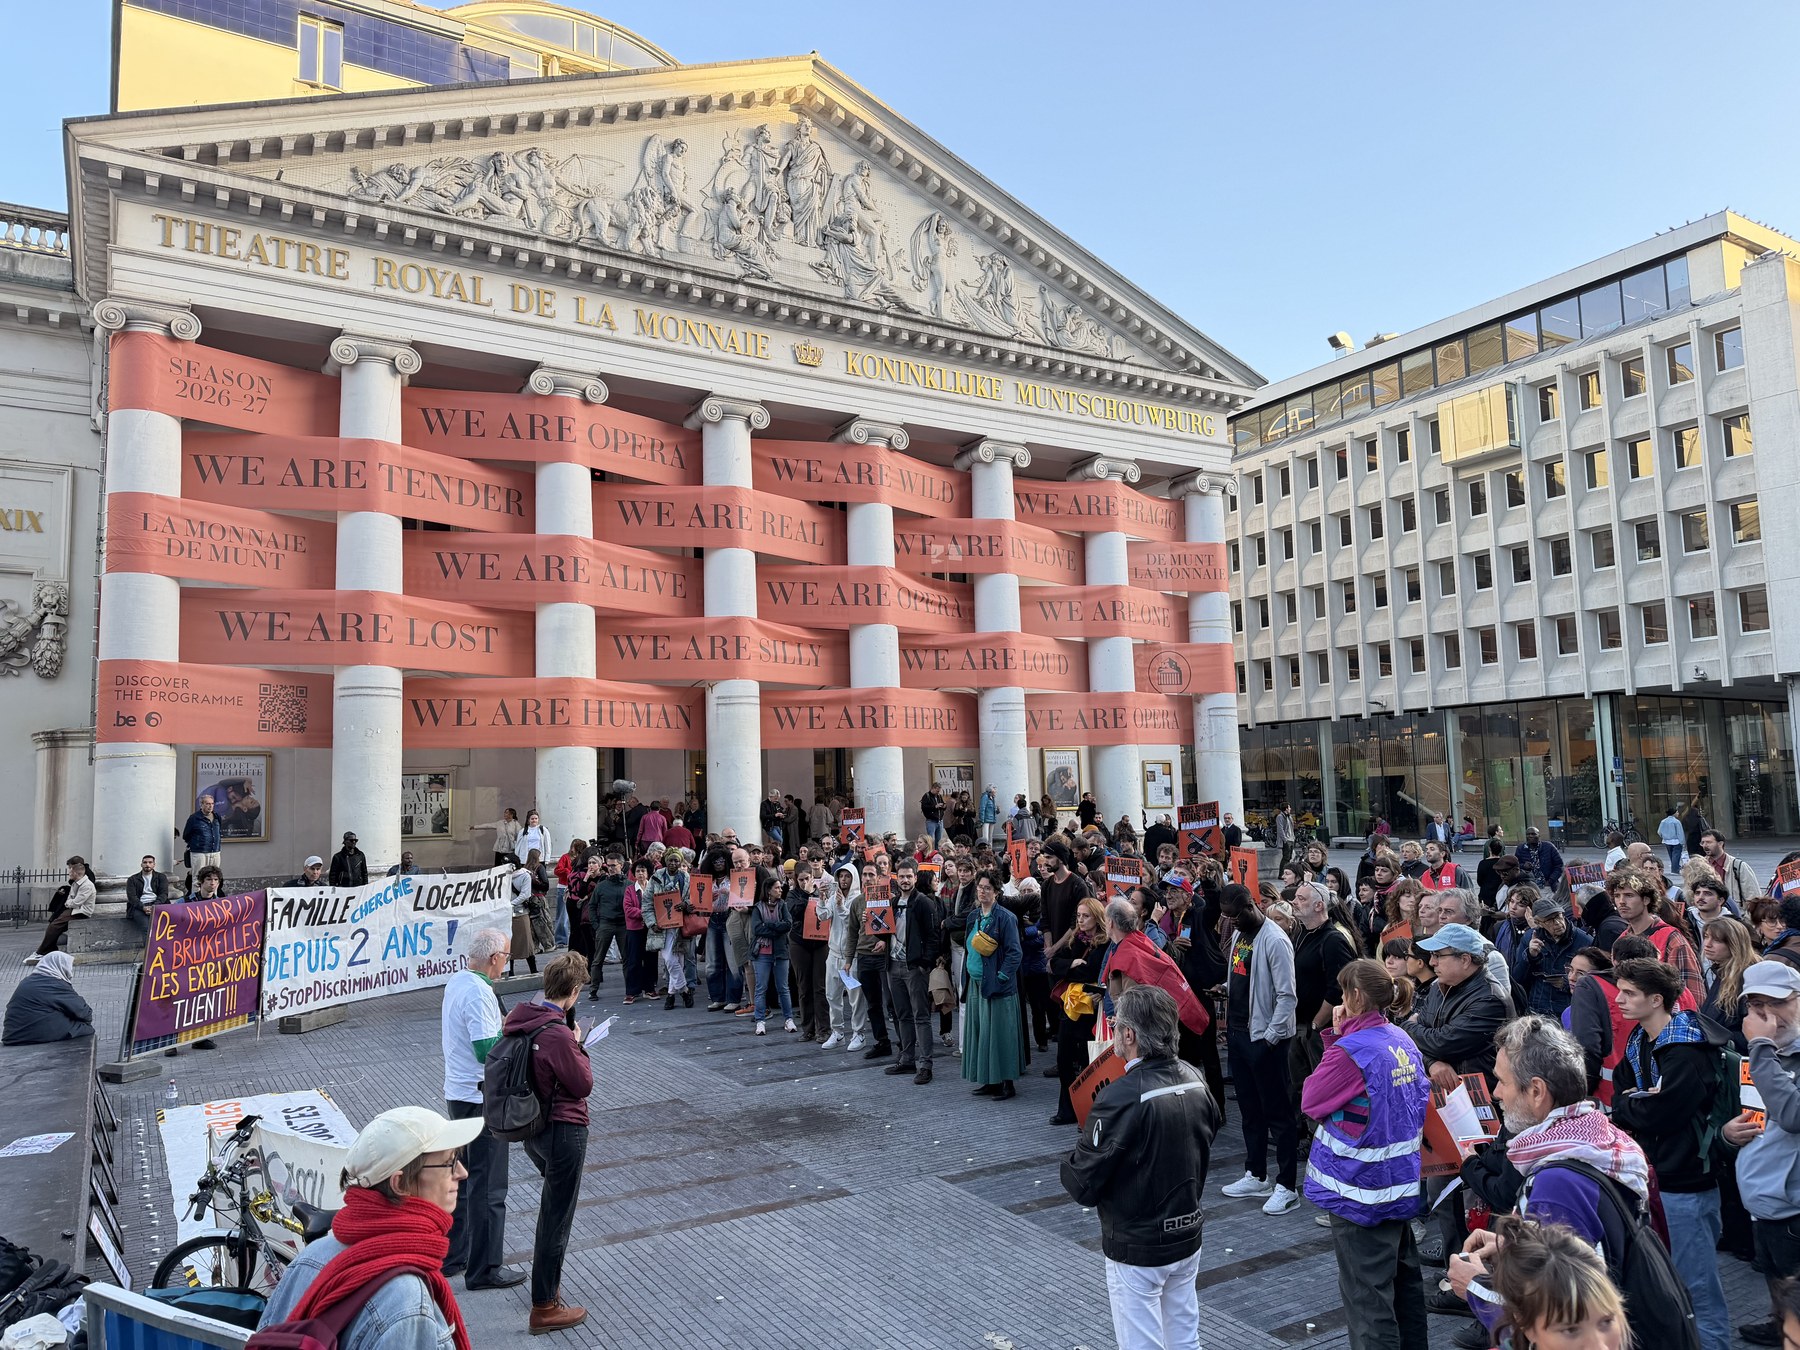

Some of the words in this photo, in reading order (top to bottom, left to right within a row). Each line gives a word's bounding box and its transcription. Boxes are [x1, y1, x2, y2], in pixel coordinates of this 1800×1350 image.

[151, 212, 351, 281] THEATRE
[373, 257, 493, 307] ROYAL
[510, 283, 556, 318] DE
[575, 296, 618, 331] LA
[633, 308, 771, 359] MONNAIE
[169, 356, 273, 396] SEASON
[844, 350, 1004, 401] KONINKLIJKE
[1016, 381, 1217, 437] MUNTSCHOUWBURG
[418, 407, 485, 437] WE
[497, 412, 577, 443] ARE
[587, 422, 687, 471] OPERA
[189, 453, 265, 487] WE
[277, 457, 367, 490] ARE
[378, 463, 525, 517] TENDER
[769, 457, 823, 484] WE
[831, 461, 892, 488] ARE
[897, 466, 955, 505] WILD
[615, 500, 675, 528] WE
[685, 502, 753, 532] ARE
[760, 508, 825, 547] REAL
[1014, 492, 1060, 516] WE
[1066, 493, 1119, 517] ARE
[1122, 496, 1178, 532] TRAGIC
[140, 512, 177, 535] LA
[184, 518, 307, 553] MONNAIE
[165, 537, 202, 561] DE
[207, 544, 286, 571] MUNT
[893, 533, 936, 557] WE
[948, 534, 1004, 558] ARE
[1010, 537, 1029, 560] IN
[1032, 541, 1077, 572] LOVE
[1145, 552, 1167, 566] DE
[1169, 553, 1215, 567] MUNT
[432, 551, 500, 581] WE
[511, 554, 590, 584] ARE
[599, 561, 687, 599] ALIVE
[1133, 567, 1154, 579] LA
[1155, 568, 1226, 581] MONNAIE
[764, 581, 819, 606] WE
[828, 581, 891, 607] ARE
[896, 585, 964, 619] OPERA
[1035, 600, 1083, 622] WE
[1090, 600, 1137, 624] ARE
[1140, 604, 1171, 628] ONE
[215, 610, 291, 642] WE
[303, 611, 394, 644] ARE
[405, 616, 499, 654] LOST
[610, 634, 672, 661] WE
[680, 634, 752, 662] ARE
[758, 637, 823, 668] SILLY
[114, 675, 190, 689] DISCOVER
[901, 649, 950, 672] WE
[957, 648, 1017, 671] ARE
[1022, 649, 1069, 677] LOUD
[114, 689, 143, 701] THE
[149, 690, 244, 707] PROGRAMME
[407, 698, 477, 727] WE
[487, 698, 571, 726] ARE
[581, 698, 693, 731] HUMAN
[770, 705, 826, 731] WE
[834, 704, 898, 730] ARE
[902, 706, 958, 732] HERE
[1024, 709, 1064, 731] WE
[1071, 707, 1128, 730] ARE
[1133, 707, 1181, 730] OPERA
[186, 895, 255, 934] MADRID
[270, 890, 356, 932] FAMILLE
[350, 877, 414, 924] CHERCHE
[413, 873, 507, 912] LOGEMENT
[266, 931, 340, 982] DEPUIS
[346, 927, 371, 968] 2
[382, 921, 433, 961] ANS
[150, 972, 180, 1001] LES
[188, 950, 260, 993] EXPULSIONS
